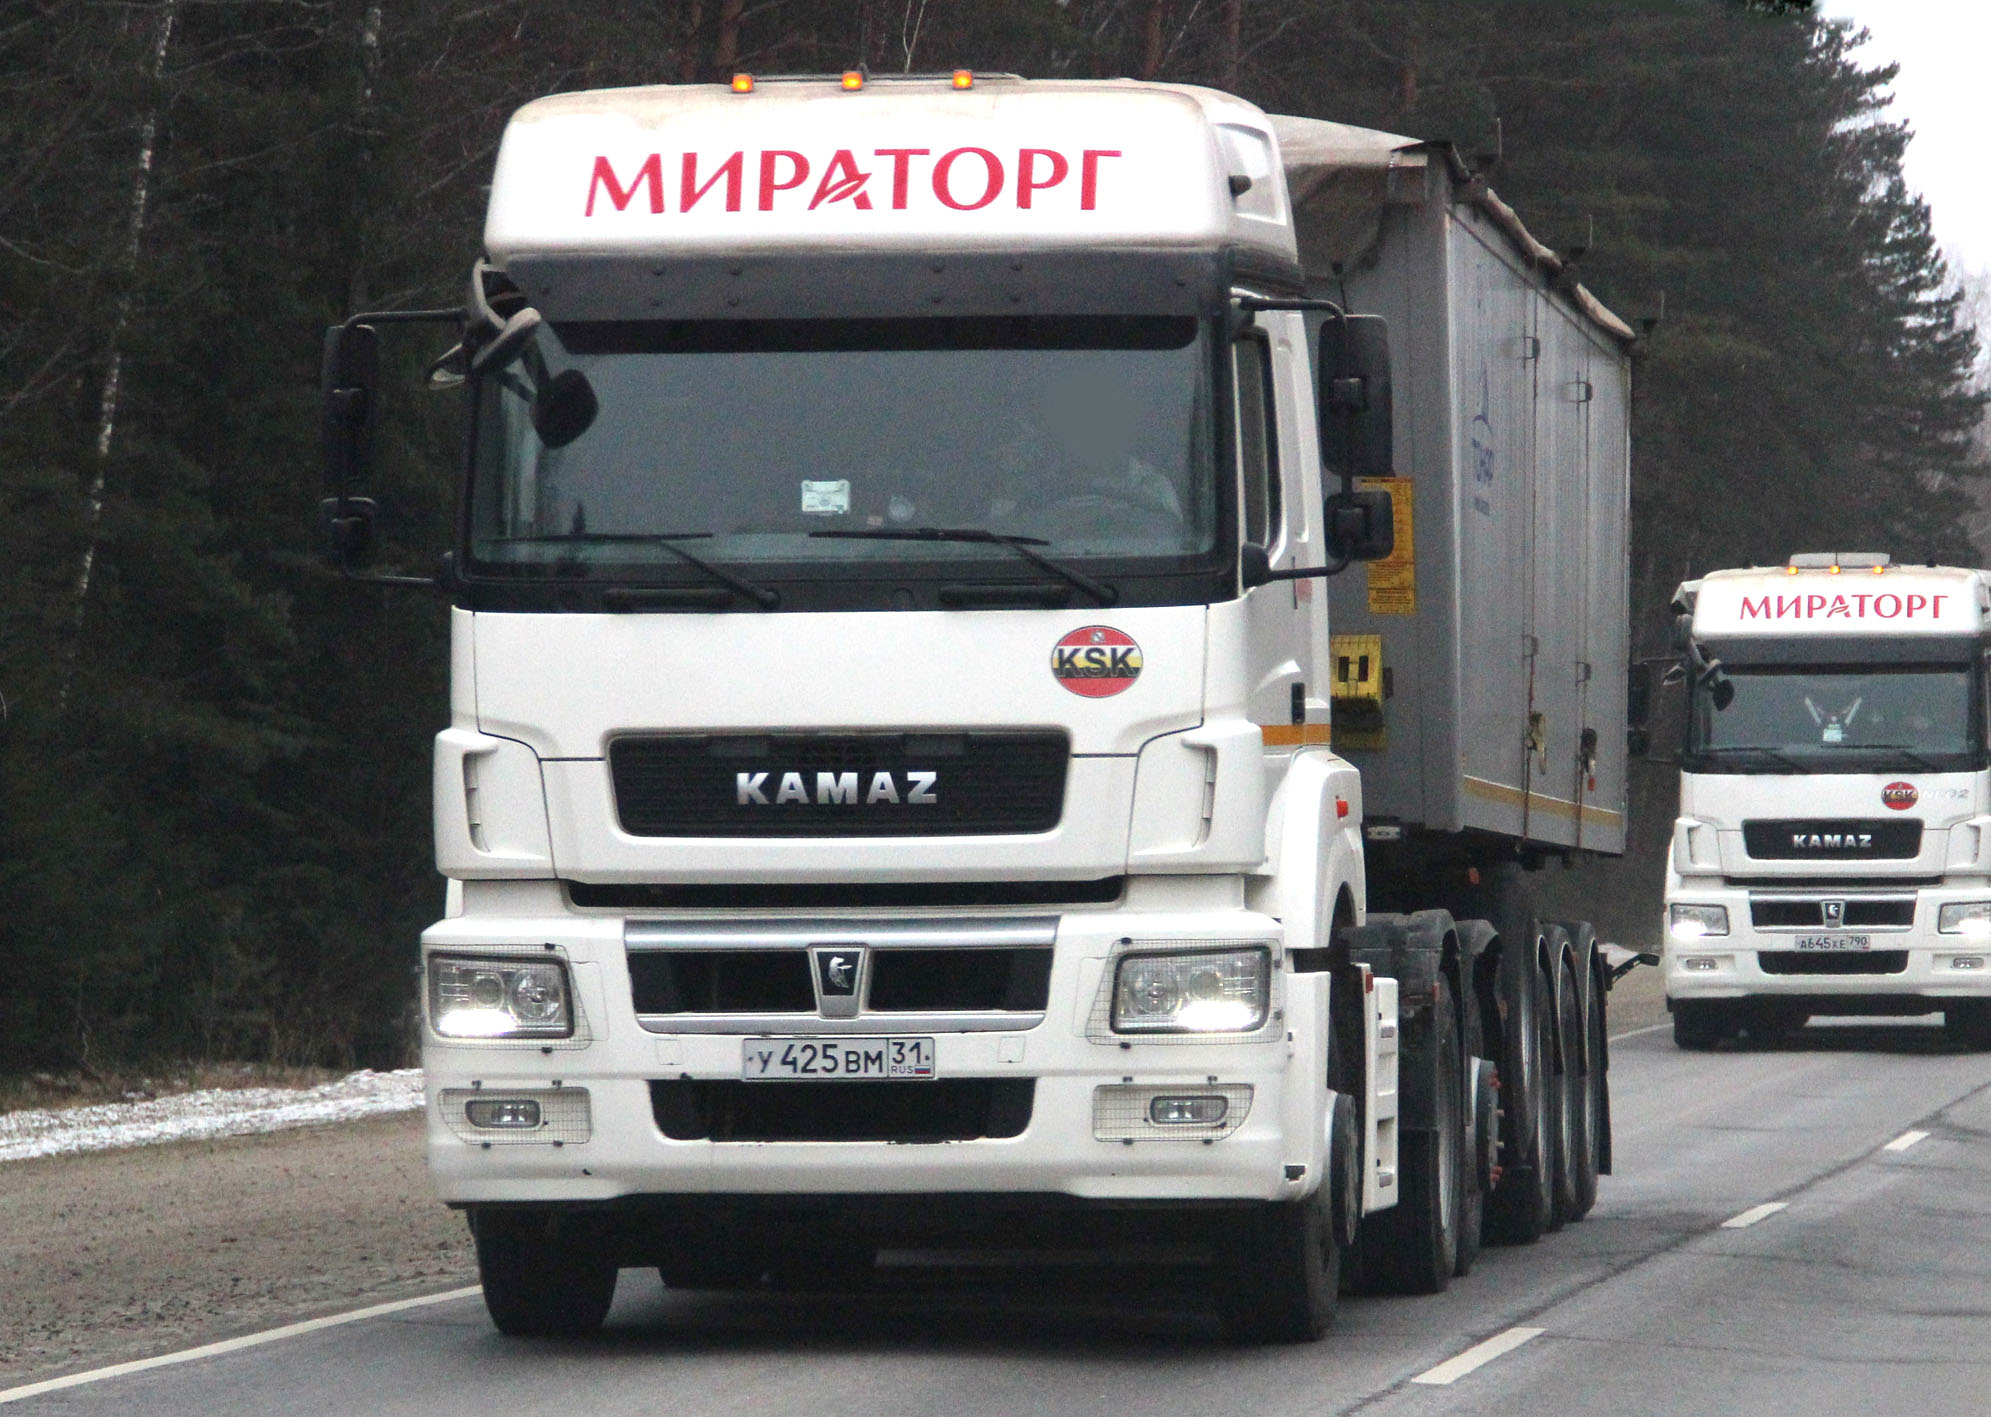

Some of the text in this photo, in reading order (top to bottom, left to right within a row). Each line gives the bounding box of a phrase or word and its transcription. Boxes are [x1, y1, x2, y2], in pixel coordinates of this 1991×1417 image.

[584, 147, 1122, 217] МИРАТОРГ
[1740, 593, 1949, 620] МИРАТОРГ
[1058, 647, 1136, 677] KSK
[736, 771, 938, 805] KAMAZ
[1793, 834, 1872, 848] KAMAZ
[891, 1065, 914, 1075] RUS
